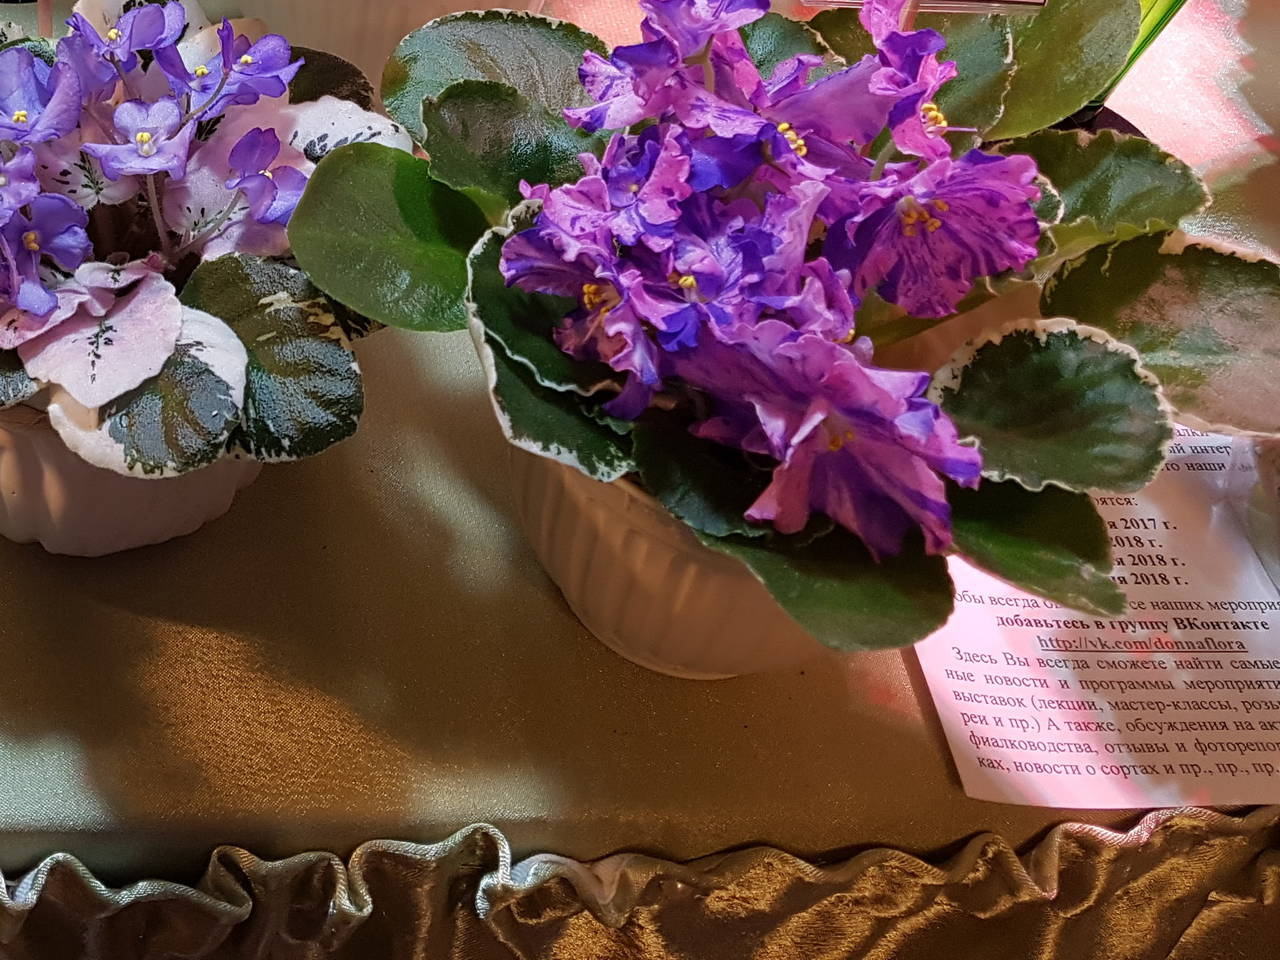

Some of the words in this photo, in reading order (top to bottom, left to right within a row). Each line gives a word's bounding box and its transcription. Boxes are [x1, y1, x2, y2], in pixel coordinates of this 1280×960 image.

[1120, 518, 1157, 530] 2017
[1162, 521, 1177, 530] г.
[1112, 536, 1144, 548] 018
[1147, 539, 1163, 548] г.
[1128, 554, 1167, 567] 2018
[1171, 557, 1186, 567] г.
[1130, 573, 1170, 585] 2018
[1174, 576, 1189, 585] г.
[989, 596, 1041, 609] всегда
[1151, 600, 1205, 611] наших
[996, 614, 1090, 630] добавьтесь
[1094, 620, 1105, 630] в
[1109, 620, 1168, 633] группу
[1172, 617, 1270, 631] ВКонтакте
[1037, 635, 1248, 652] http://vk.com/donnaflora
[952, 646, 998, 665] Здесь
[1002, 651, 1030, 667] Вы
[1037, 657, 1090, 670] всегда
[1096, 659, 1168, 670] сможете
[1173, 657, 1223, 670] найти
[945, 668, 976, 682] ные
[984, 674, 1049, 689] новости
[1058, 679, 1070, 689] и
[1079, 679, 1175, 693] программы
[952, 690, 1028, 708] выставок
[1031, 695, 1104, 712] (лекции,
[1107, 700, 1239, 714] мастер-классы,
[960, 711, 988, 727] реи
[992, 716, 1004, 727] и
[1009, 719, 1041, 733] пр.)
[1047, 717, 1061, 731] А
[1064, 720, 1121, 734] также,
[1126, 718, 1230, 735] обсуждения
[1233, 720, 1255, 731] на
[969, 730, 1099, 755] фиалководства,
[1104, 742, 1170, 753] отзывы
[1175, 742, 1188, 752] и
[977, 756, 1011, 773] ках,
[1013, 761, 1081, 776] новости
[1086, 765, 1096, 775] о
[1101, 764, 1160, 778] сортах
[1163, 763, 1175, 774] и
[1179, 762, 1214, 778] пр.,
[1216, 762, 1250, 777] пр.,
